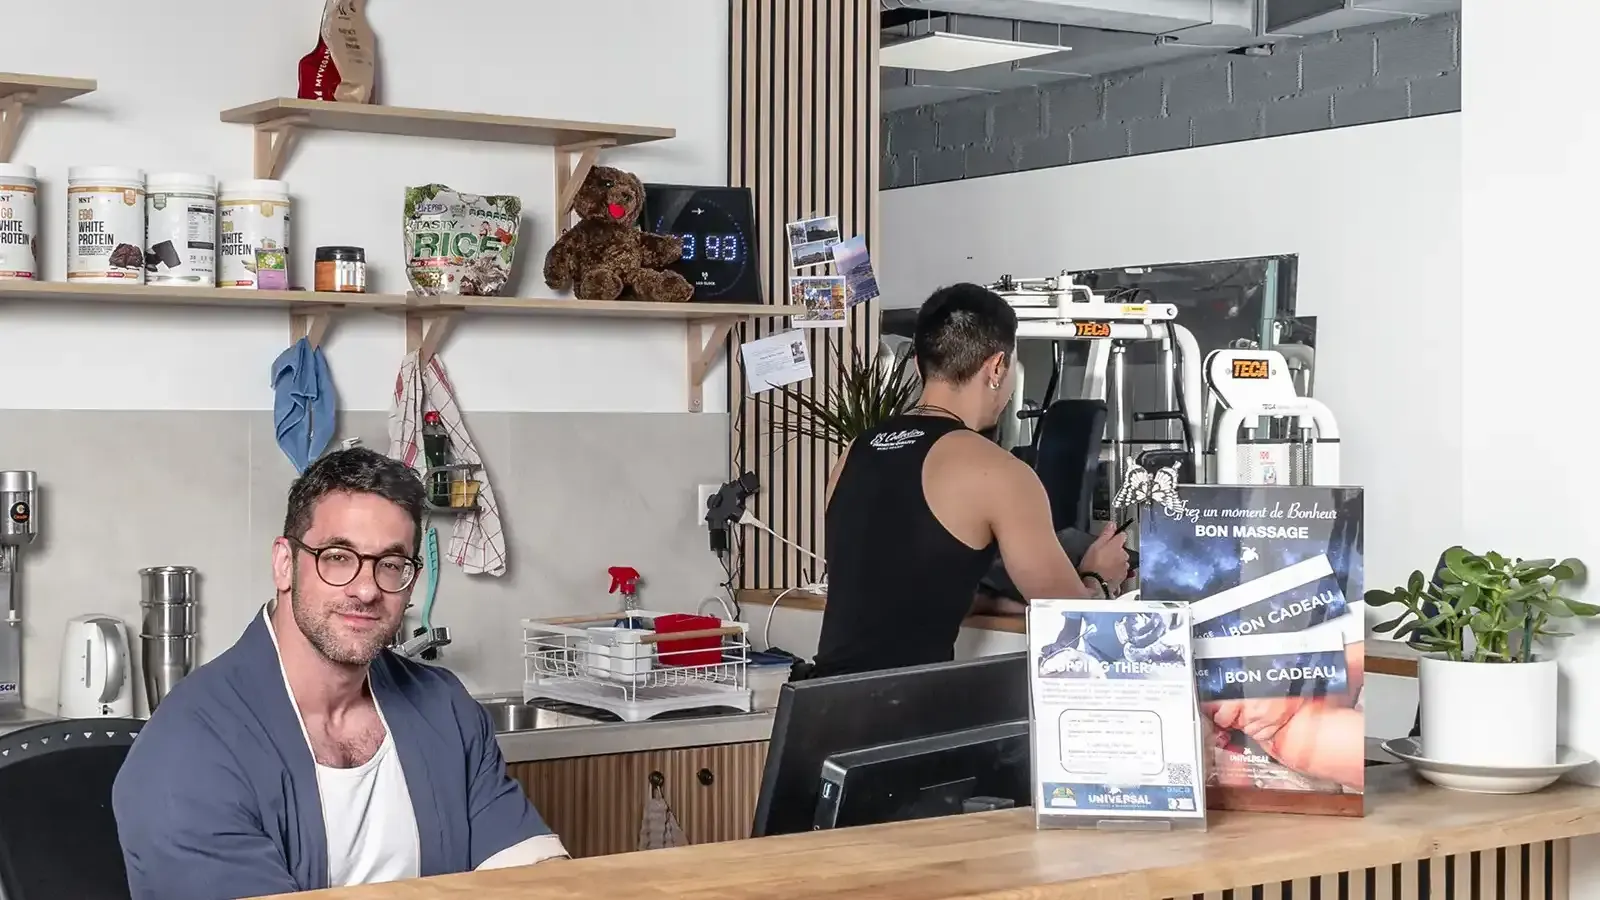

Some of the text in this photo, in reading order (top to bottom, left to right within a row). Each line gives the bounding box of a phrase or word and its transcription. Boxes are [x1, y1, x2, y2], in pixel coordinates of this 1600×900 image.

[0, 208, 13, 219] GG
[78, 209, 94, 220] EGG
[78, 221, 105, 233] WHITE
[416, 220, 459, 231] TASTY
[0, 232, 30, 245] ROTEIN
[78, 233, 114, 245] PROTEIN
[221, 232, 244, 244] WHITE
[221, 244, 252, 256] PROTEIN
[413, 232, 502, 258] RICE
[1075, 322, 1110, 337] TECA
[1233, 360, 1268, 378] TECA
[1203, 509, 1220, 518] un
[1221, 507, 1267, 518] moment
[1269, 501, 1284, 518] de
[1287, 502, 1338, 520] Bonheur
[1195, 525, 1309, 539] BON MASSAGE
[1228, 590, 1334, 637] BON CADEAU
[1225, 666, 1336, 683] BON CADEAU
[1087, 793, 1152, 806] UNIVERSAL
